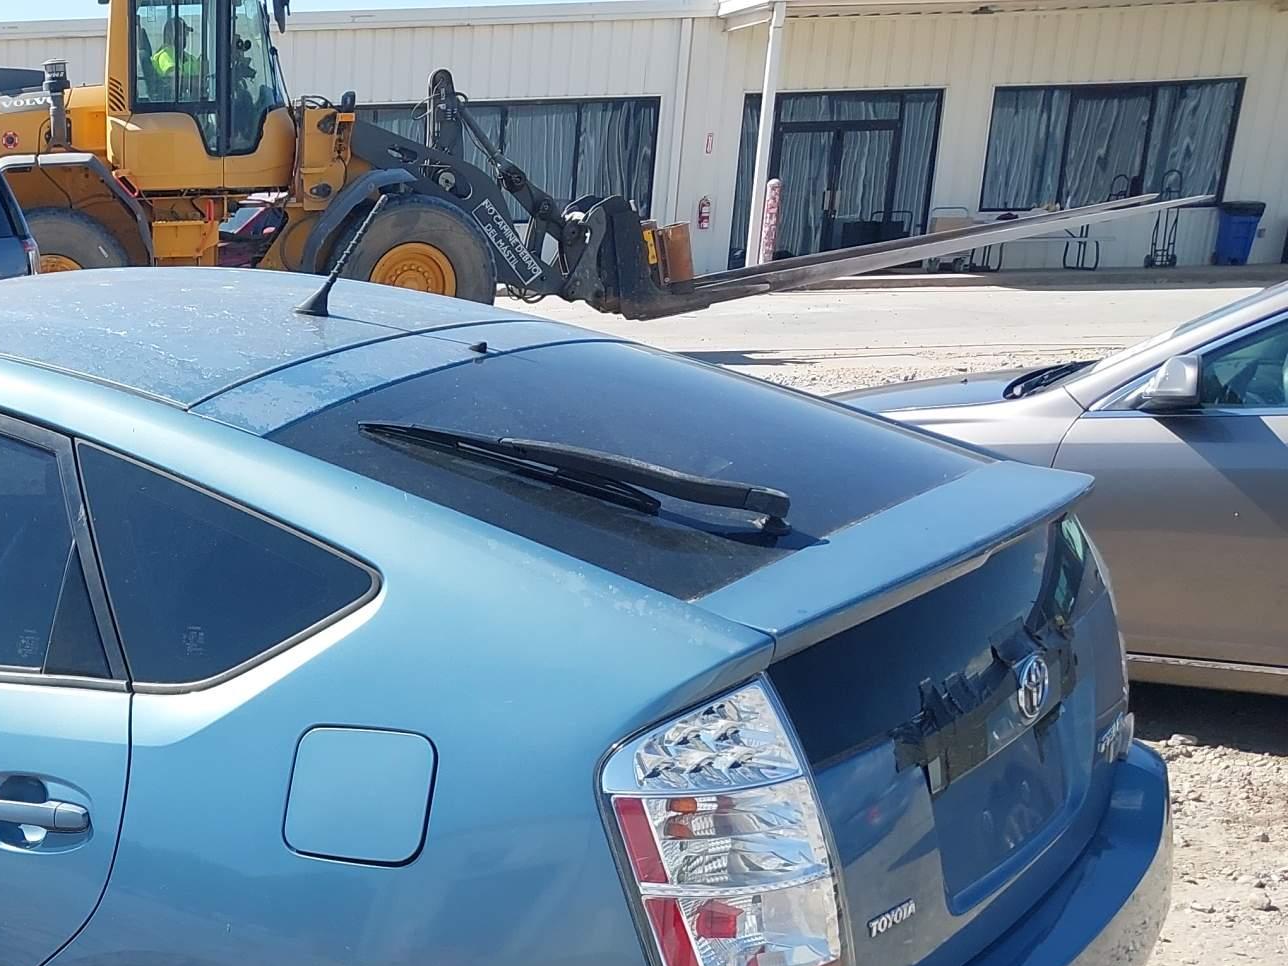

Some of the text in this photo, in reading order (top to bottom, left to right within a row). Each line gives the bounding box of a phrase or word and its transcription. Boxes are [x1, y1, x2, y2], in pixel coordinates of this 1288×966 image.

[482, 199, 538, 274] NO CAMINE DEBAJO
[485, 223, 519, 268] DEL MÁSTIL
[869, 899, 916, 938] TOYOTA
